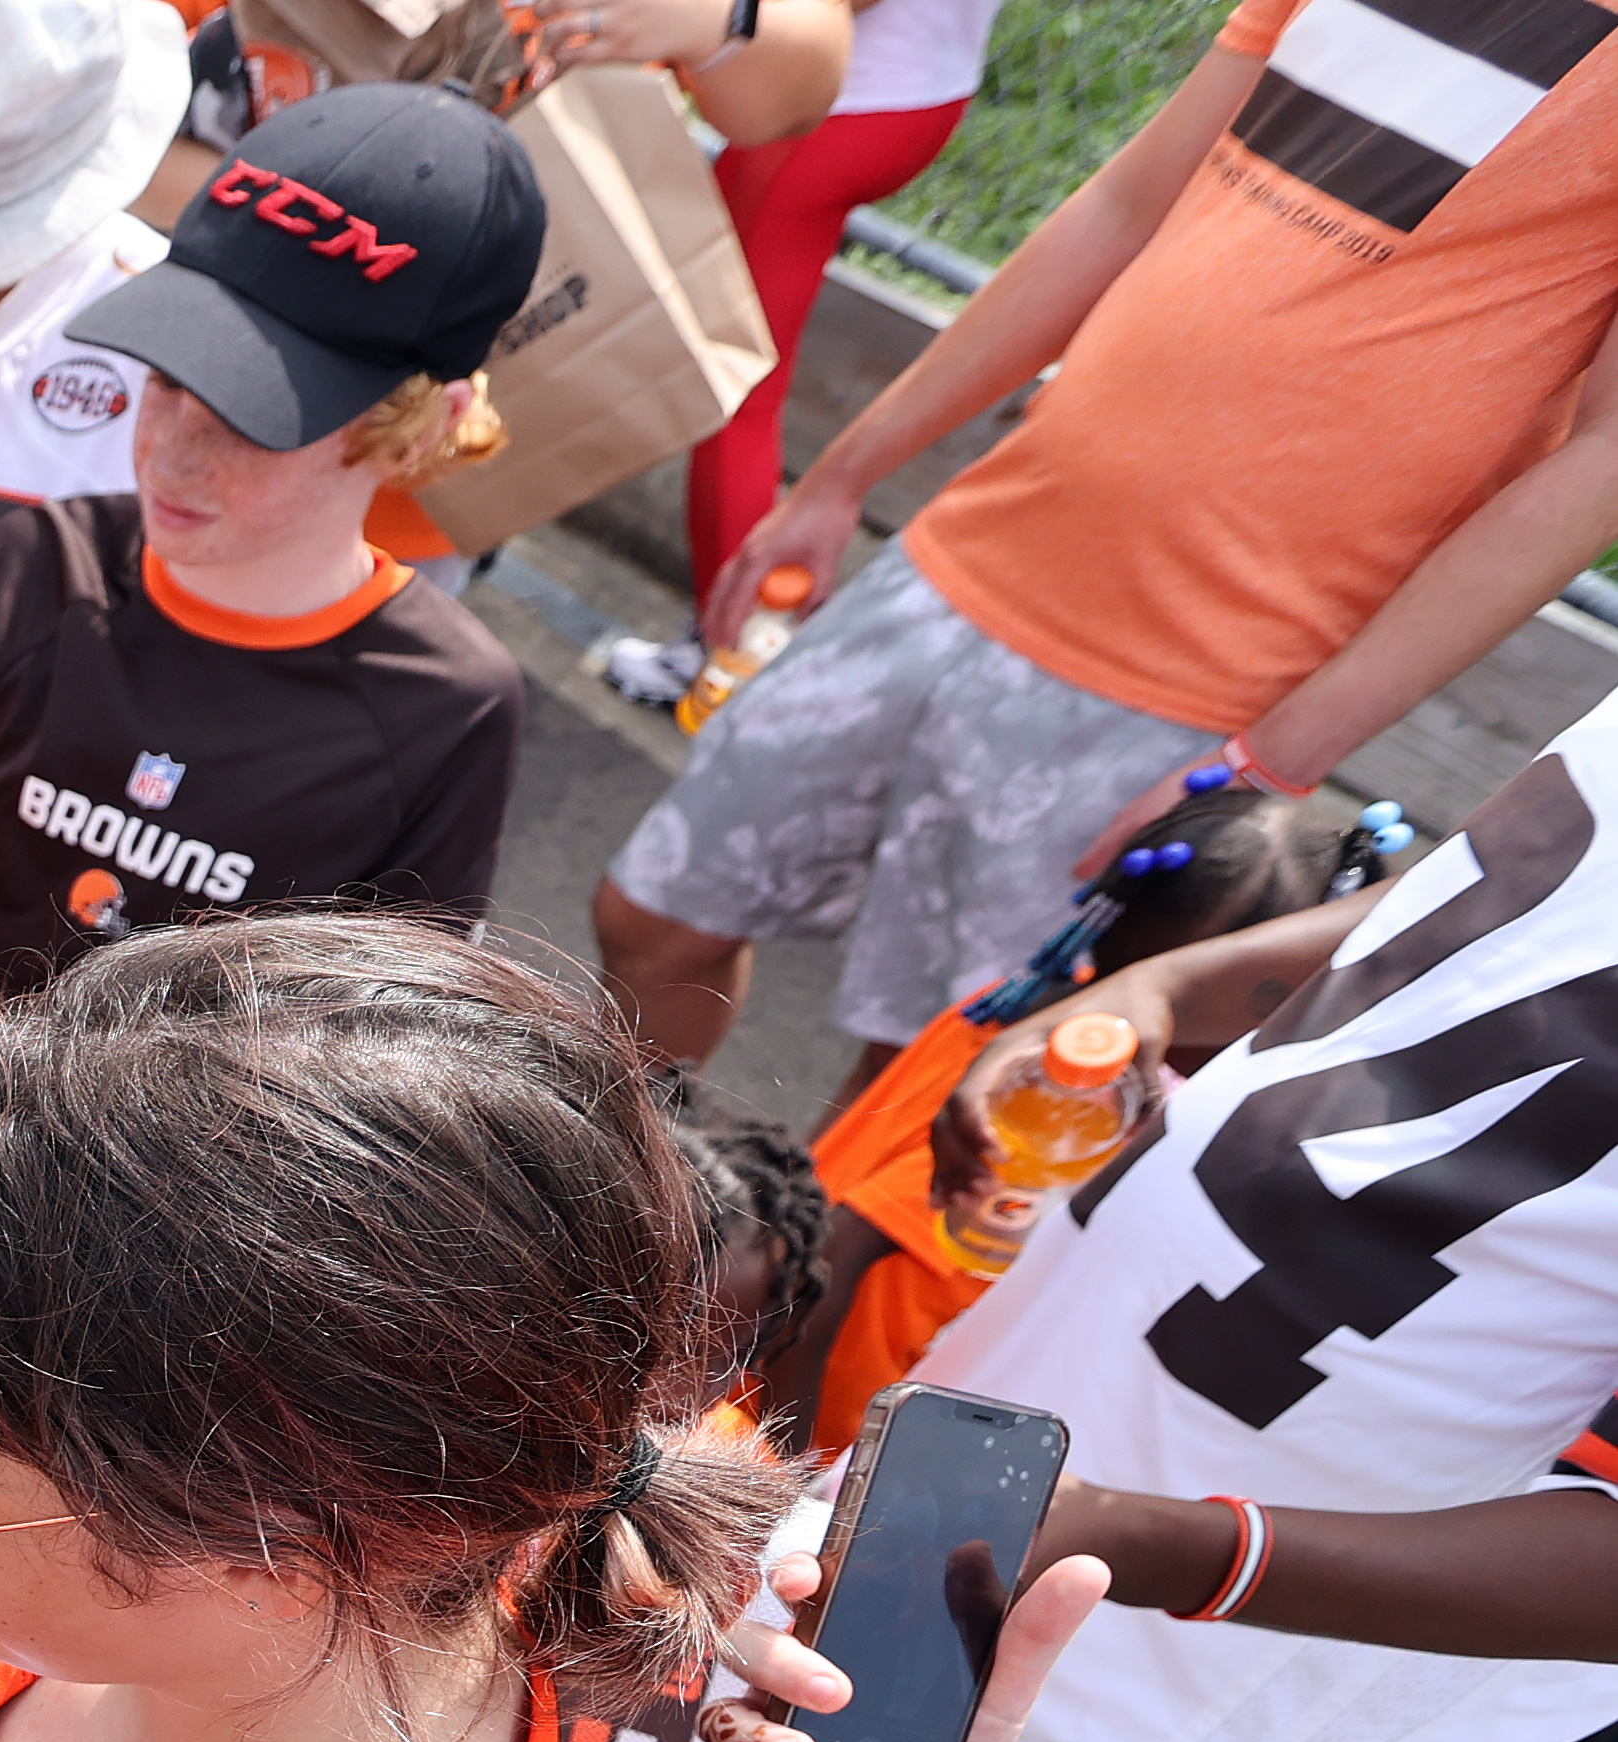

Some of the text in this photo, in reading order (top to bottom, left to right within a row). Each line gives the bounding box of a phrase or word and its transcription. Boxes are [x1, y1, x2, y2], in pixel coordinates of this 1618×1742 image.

[208, 157, 419, 284] CCM
[18, 774, 256, 903] BROWNS
[131, 772, 170, 804] NFL
